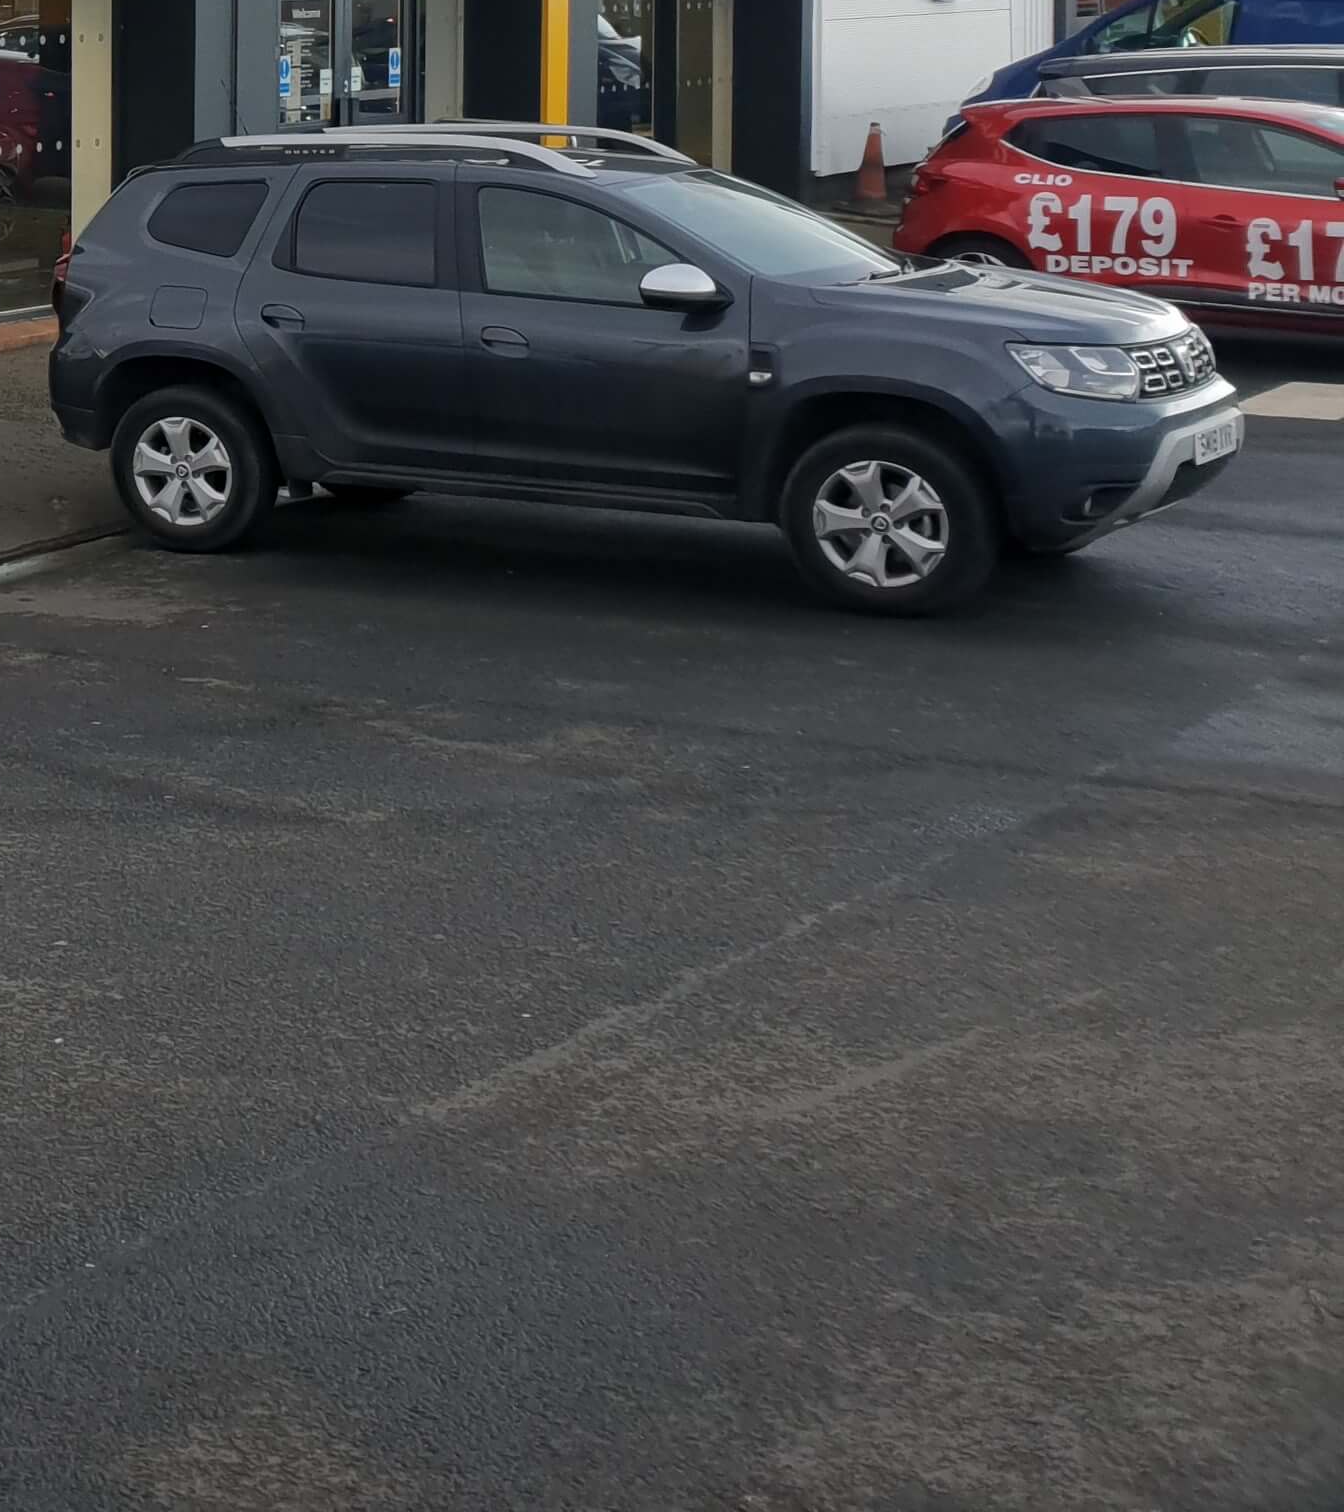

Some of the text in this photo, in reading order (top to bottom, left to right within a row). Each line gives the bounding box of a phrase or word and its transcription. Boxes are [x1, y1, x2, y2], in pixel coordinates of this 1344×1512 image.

[1014, 173, 1073, 187] CLIO
[1027, 191, 1178, 258] £179
[1046, 254, 1194, 278] DEPOSIT
[1248, 281, 1301, 303] PER
